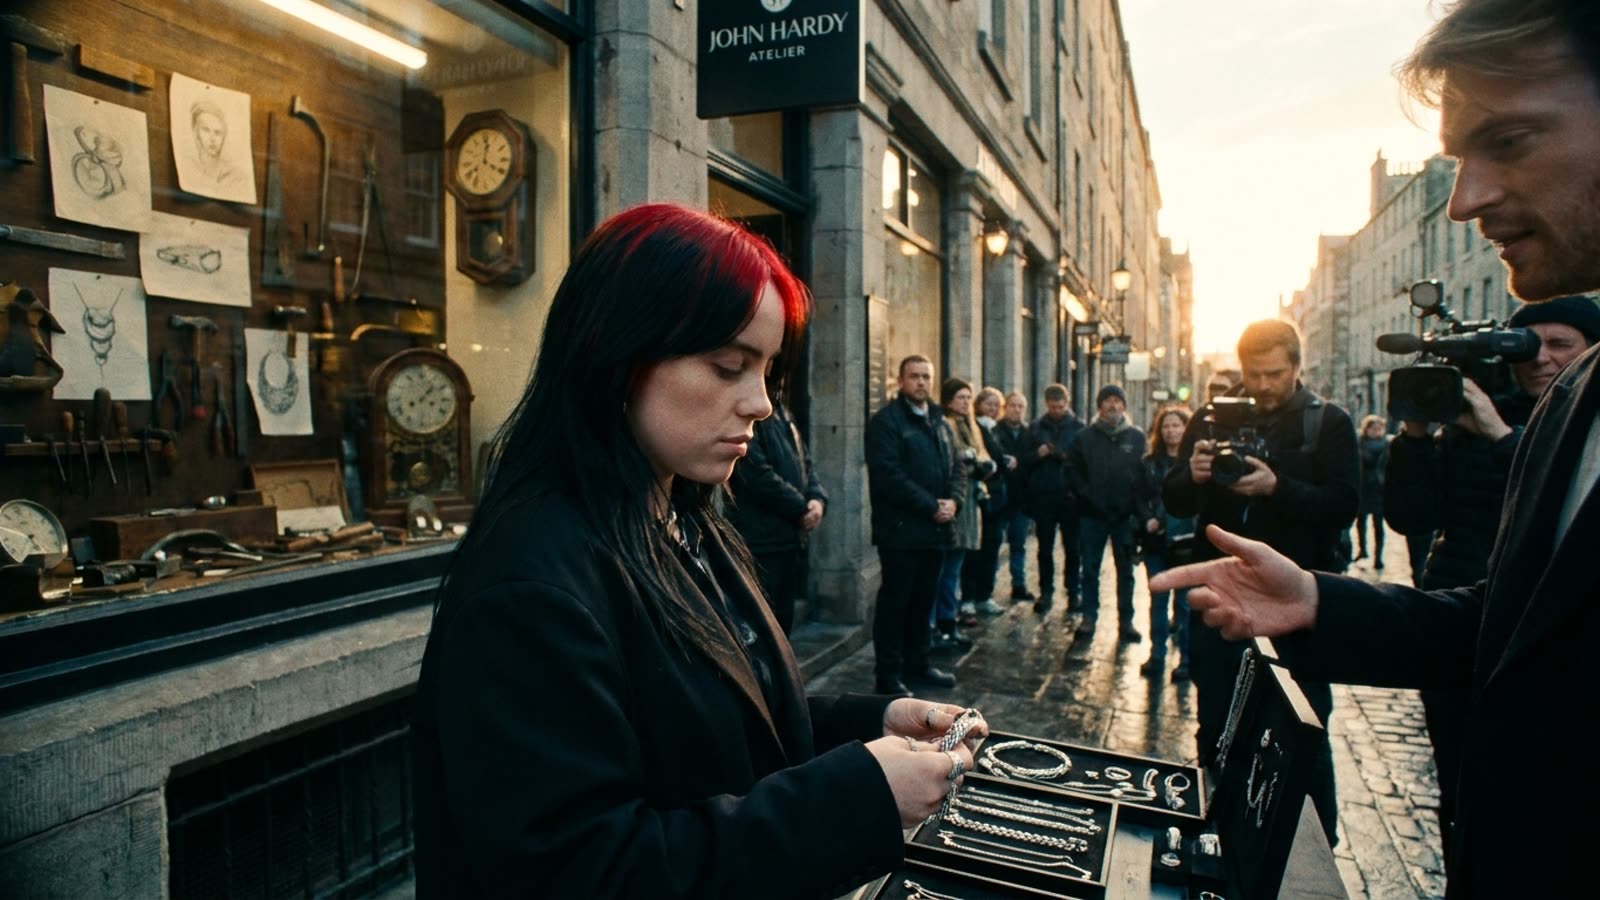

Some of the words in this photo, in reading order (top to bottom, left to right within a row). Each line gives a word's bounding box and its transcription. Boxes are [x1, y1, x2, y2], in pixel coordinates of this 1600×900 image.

[709, 24, 764, 52] JOHN
[771, 12, 848, 41] HARDY
[749, 45, 805, 62] ATELIER
